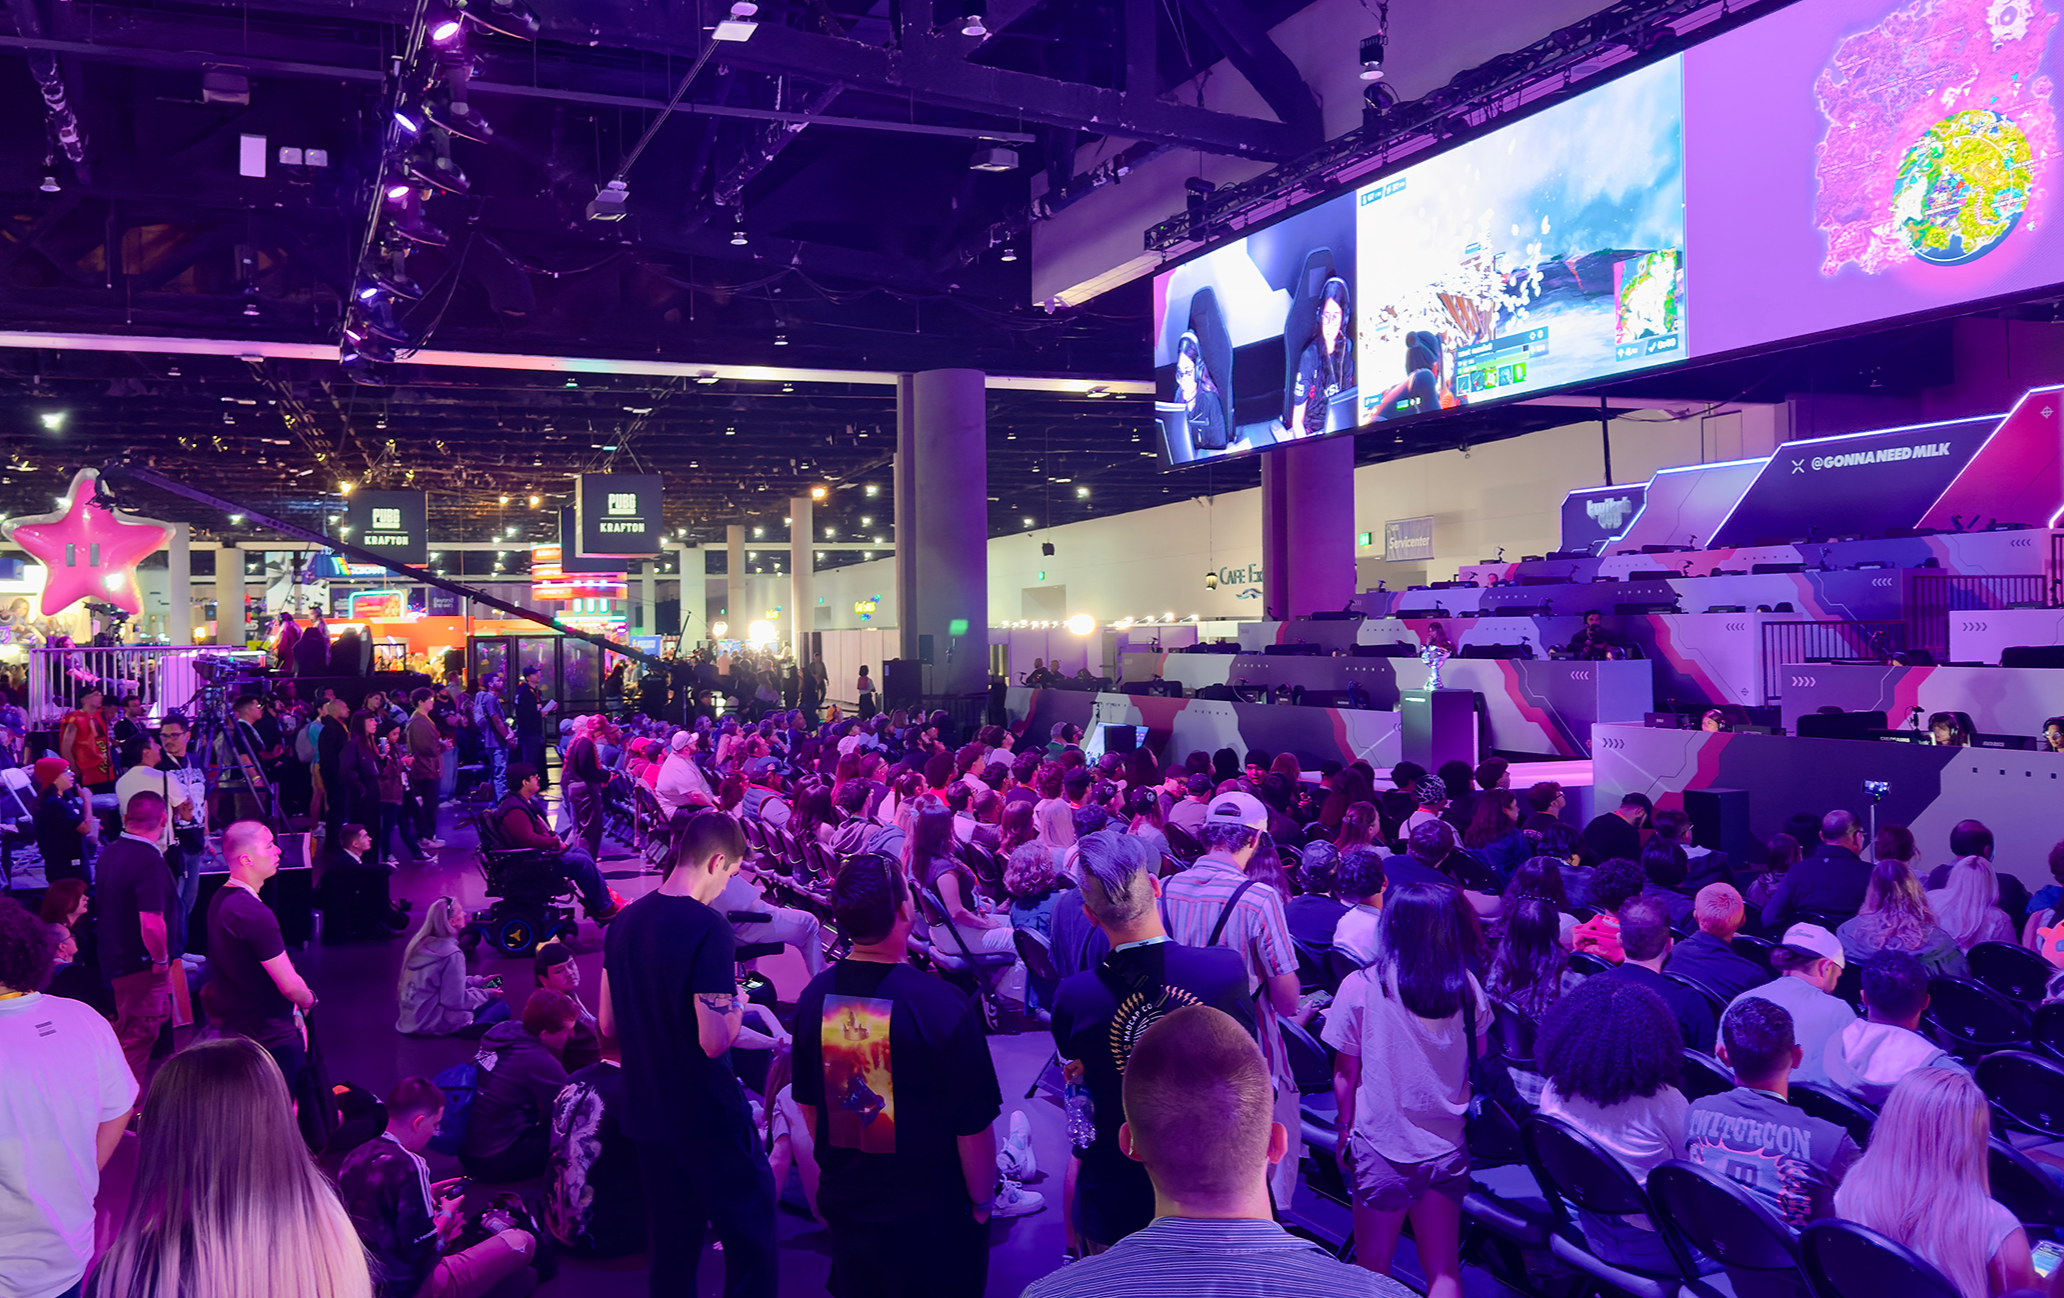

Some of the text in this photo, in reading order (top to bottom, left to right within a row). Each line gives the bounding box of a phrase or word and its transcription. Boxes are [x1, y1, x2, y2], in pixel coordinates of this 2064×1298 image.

[608, 493, 637, 509] PUBG
[372, 508, 400, 523] PUBG
[600, 522, 645, 533] KRAFTON
[364, 535, 409, 546] KRAFTON
[1389, 536, 1430, 550] Servicenter
[1123, 1010, 1140, 1042] MADCAP
[1689, 1109, 1812, 1161] TWITCHCON
